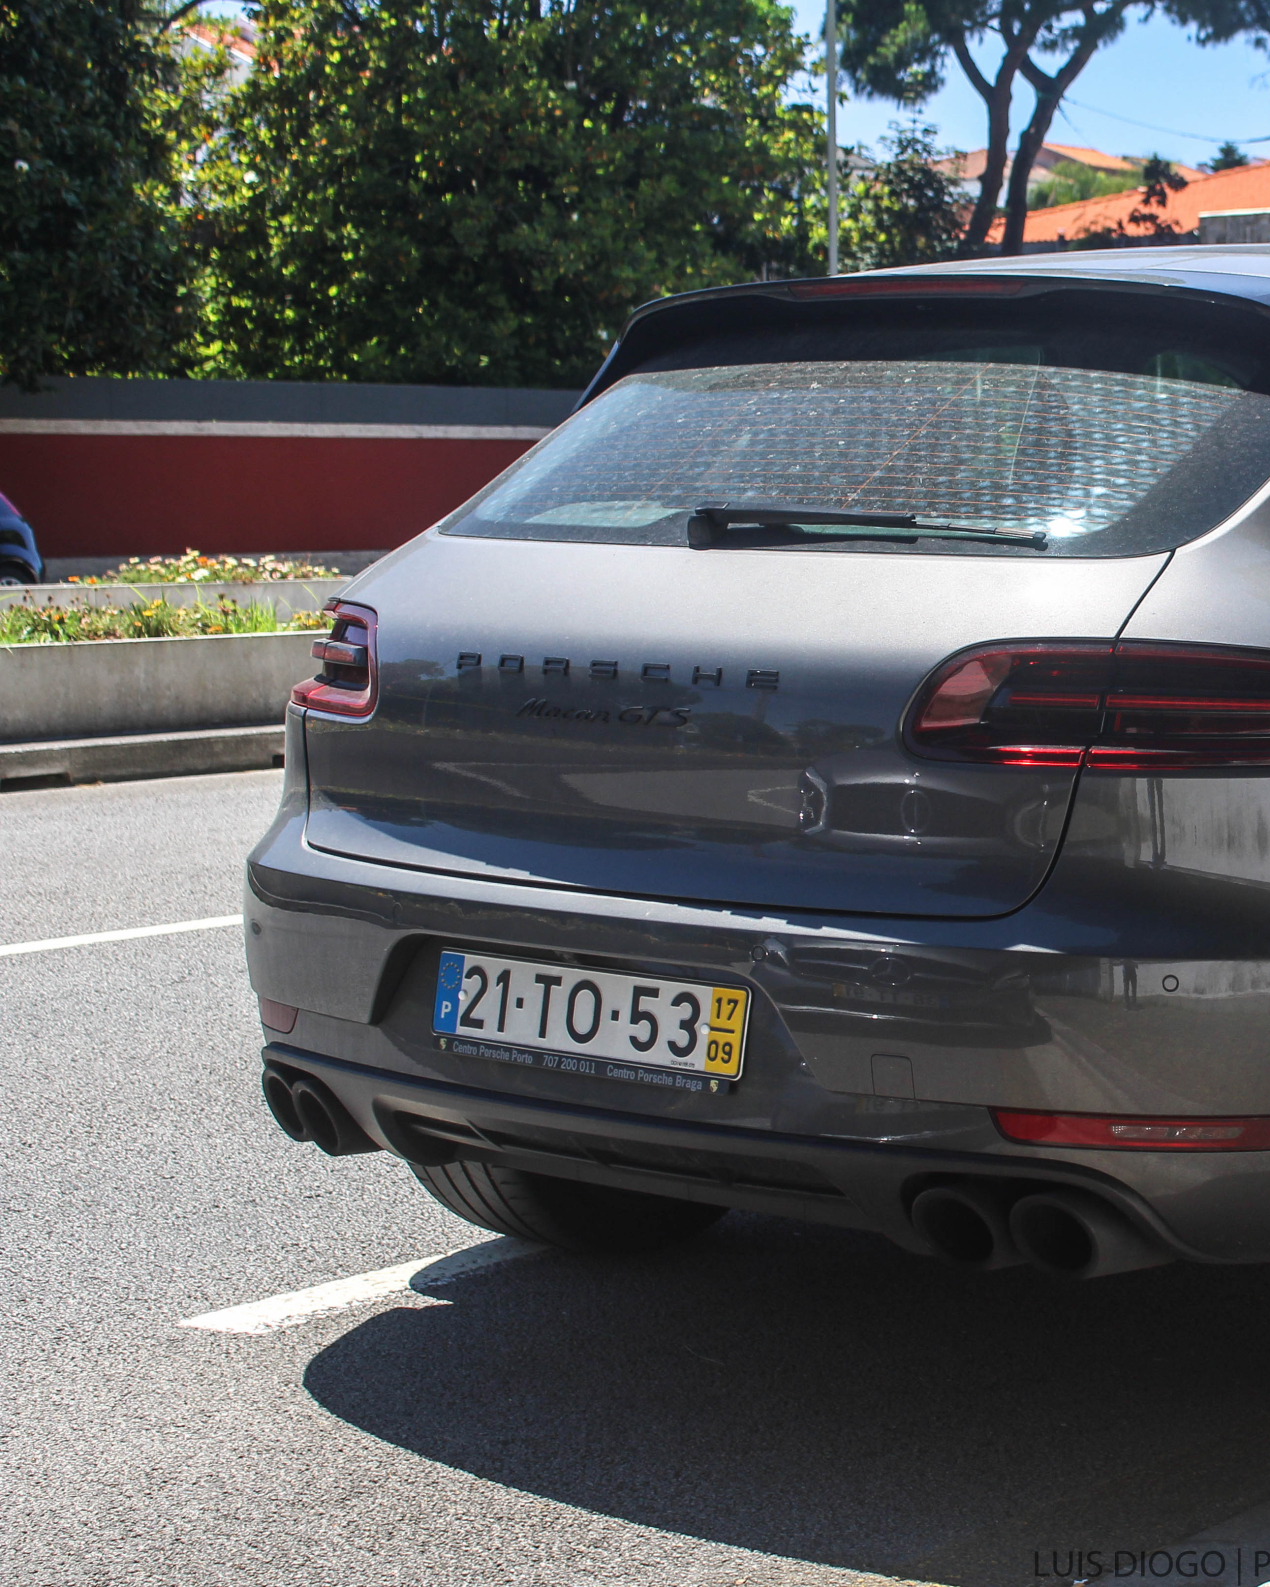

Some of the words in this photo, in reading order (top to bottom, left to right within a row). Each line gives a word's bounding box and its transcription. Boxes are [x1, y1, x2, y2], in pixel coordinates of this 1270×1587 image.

[456, 651, 779, 691] PORSCHE
[515, 698, 610, 723] Macan
[618, 706, 690, 728] GTS
[440, 1000, 452, 1018] P
[715, 997, 739, 1021] 17
[707, 1040, 733, 1064] 09
[452, 1041, 477, 1055] Centro
[479, 1045, 509, 1061] Porsche
[511, 1049, 533, 1064] Porto
[543, 1054, 559, 1068] 707
[560, 1057, 577, 1071] 200
[579, 1060, 596, 1074] 011
[606, 1064, 635, 1080] Centro
[637, 1069, 673, 1086] Porsche
[675, 1075, 703, 1091] Braga
